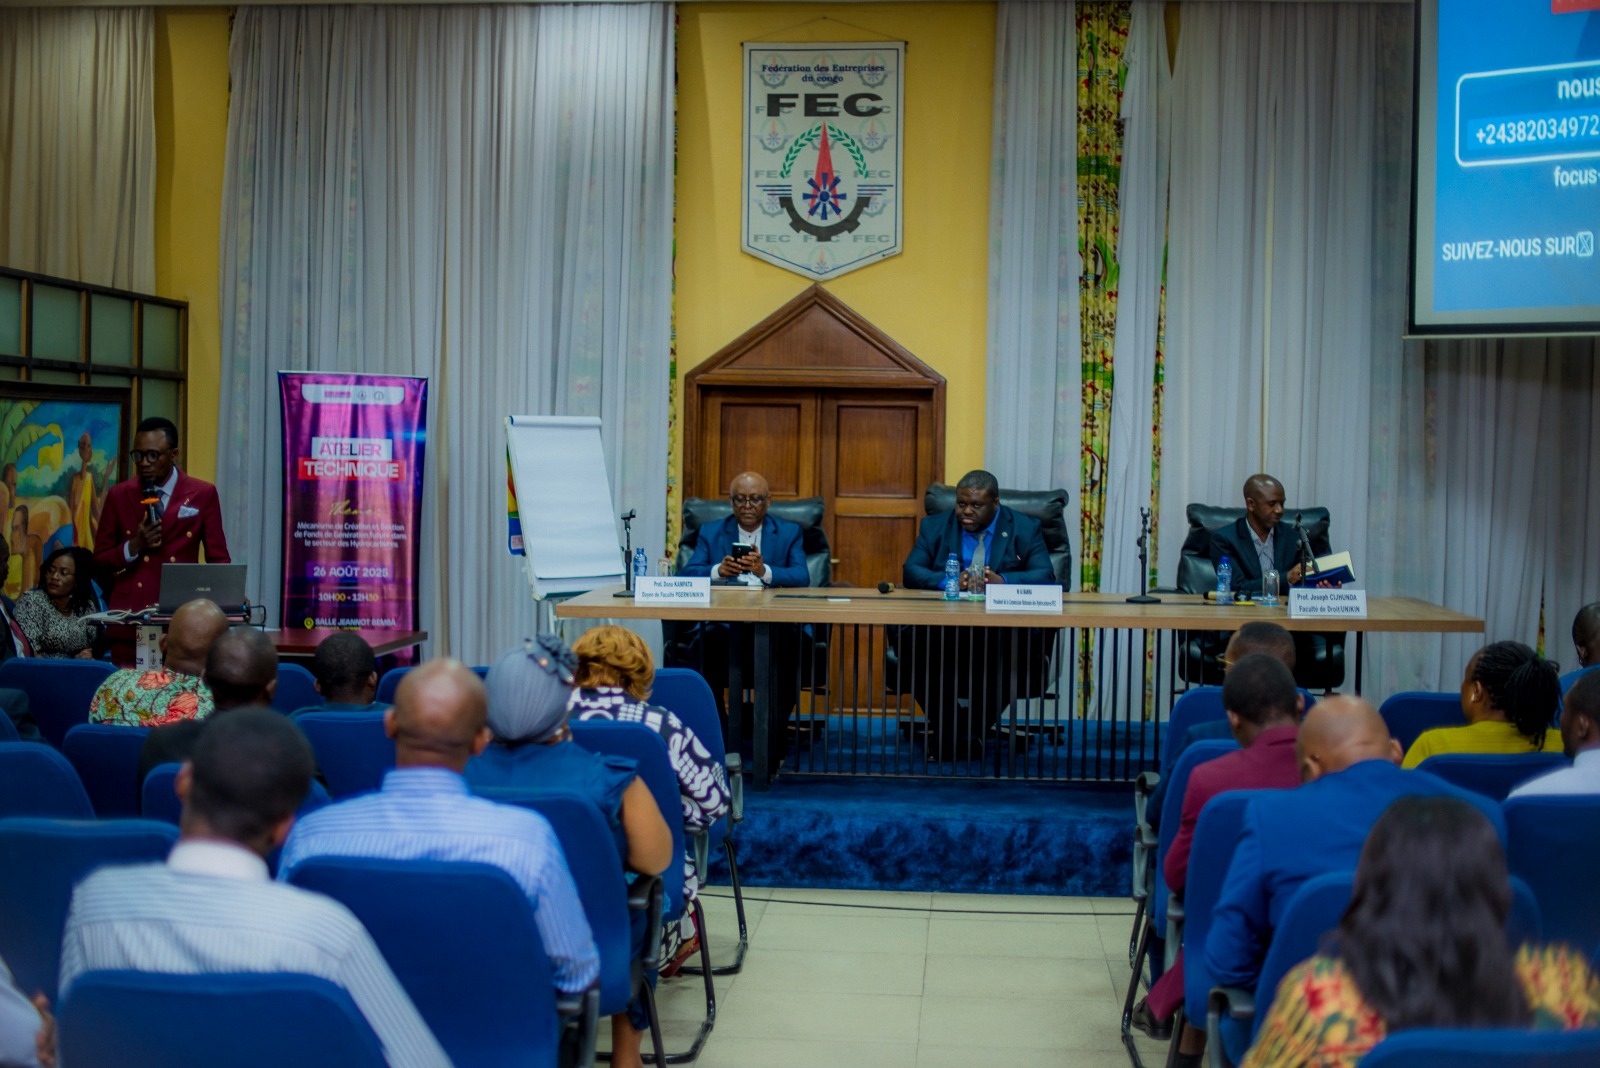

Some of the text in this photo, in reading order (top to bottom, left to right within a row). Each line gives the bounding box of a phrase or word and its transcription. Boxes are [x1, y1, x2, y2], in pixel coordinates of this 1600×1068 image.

[814, 64, 830, 73] des
[832, 64, 885, 74] Entreprises
[817, 76, 844, 84] congo
[767, 93, 883, 117] FEC
[755, 106, 792, 114] FC
[1476, 115, 1600, 145] +24382034972
[754, 170, 791, 178] FEC
[804, 170, 840, 178] FC
[853, 170, 890, 178] FEC
[753, 234, 791, 243] FEC
[803, 234, 840, 243] FC
[852, 234, 890, 243] FEC
[1442, 236, 1575, 261] SUIVEZ-NOUS SUR
[320, 442, 381, 457] ATELIER
[304, 461, 399, 478] TECHNIQUE
[297, 522, 334, 530] Mécanisme
[344, 523, 371, 531] Création
[338, 540, 349, 548] des
[350, 540, 398, 549] Hydrocarbures
[313, 565, 389, 577] 26 AOÛT 2025
[318, 592, 346, 602] 10H00
[352, 592, 379, 602] 12H30
[1310, 594, 1329, 602] Joseph
[315, 618, 337, 626] SALLE
